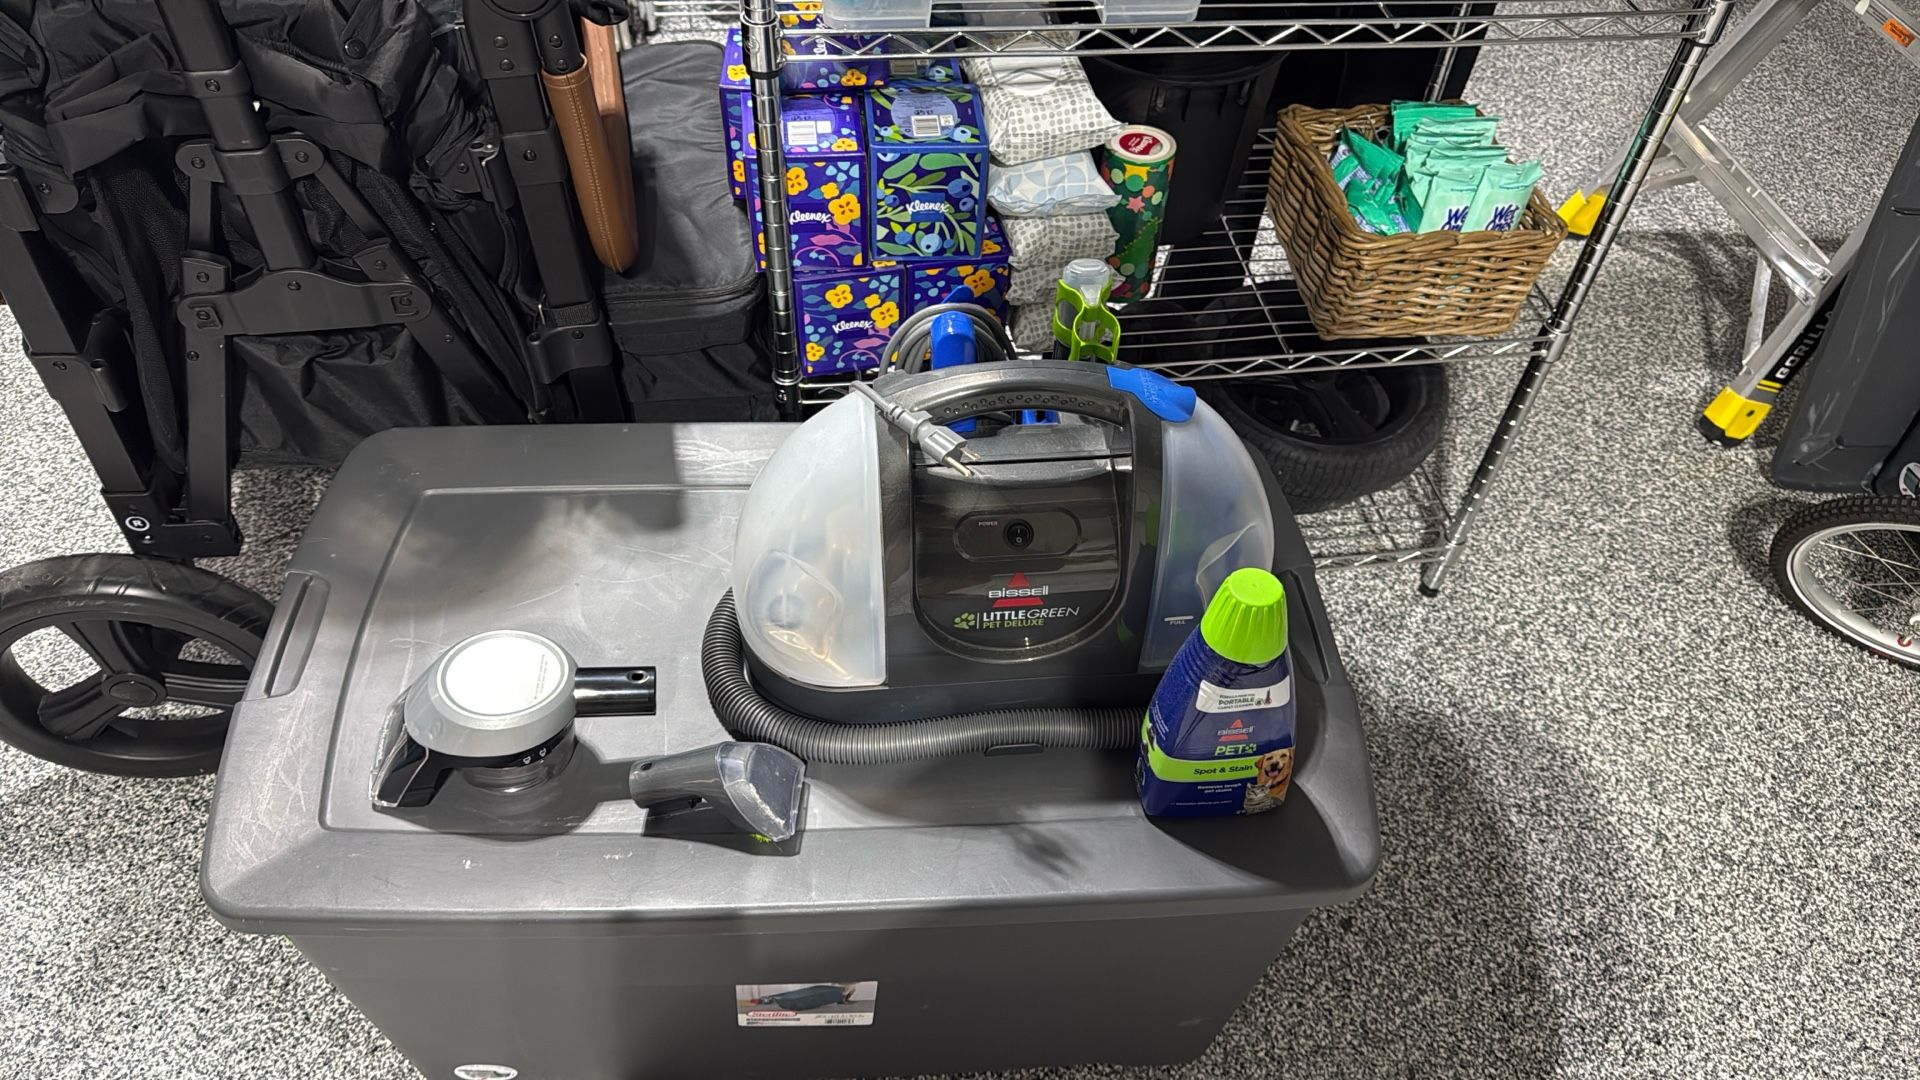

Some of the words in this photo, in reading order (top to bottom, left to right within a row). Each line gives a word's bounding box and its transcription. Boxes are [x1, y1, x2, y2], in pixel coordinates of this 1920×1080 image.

[905, 200, 950, 214] Kleenex
[1447, 205, 1470, 223] We
[1493, 203, 1520, 223] Wet
[789, 210, 832, 225] Kleenex
[832, 320, 874, 334] Kleenex
[982, 620, 1002, 629] PET
[1004, 618, 1045, 628] DELUXE
[1217, 697, 1256, 706] PORTABLE
[1214, 744, 1247, 757] PET
[1192, 767, 1217, 776] Spot
[1228, 764, 1253, 773] Stain
